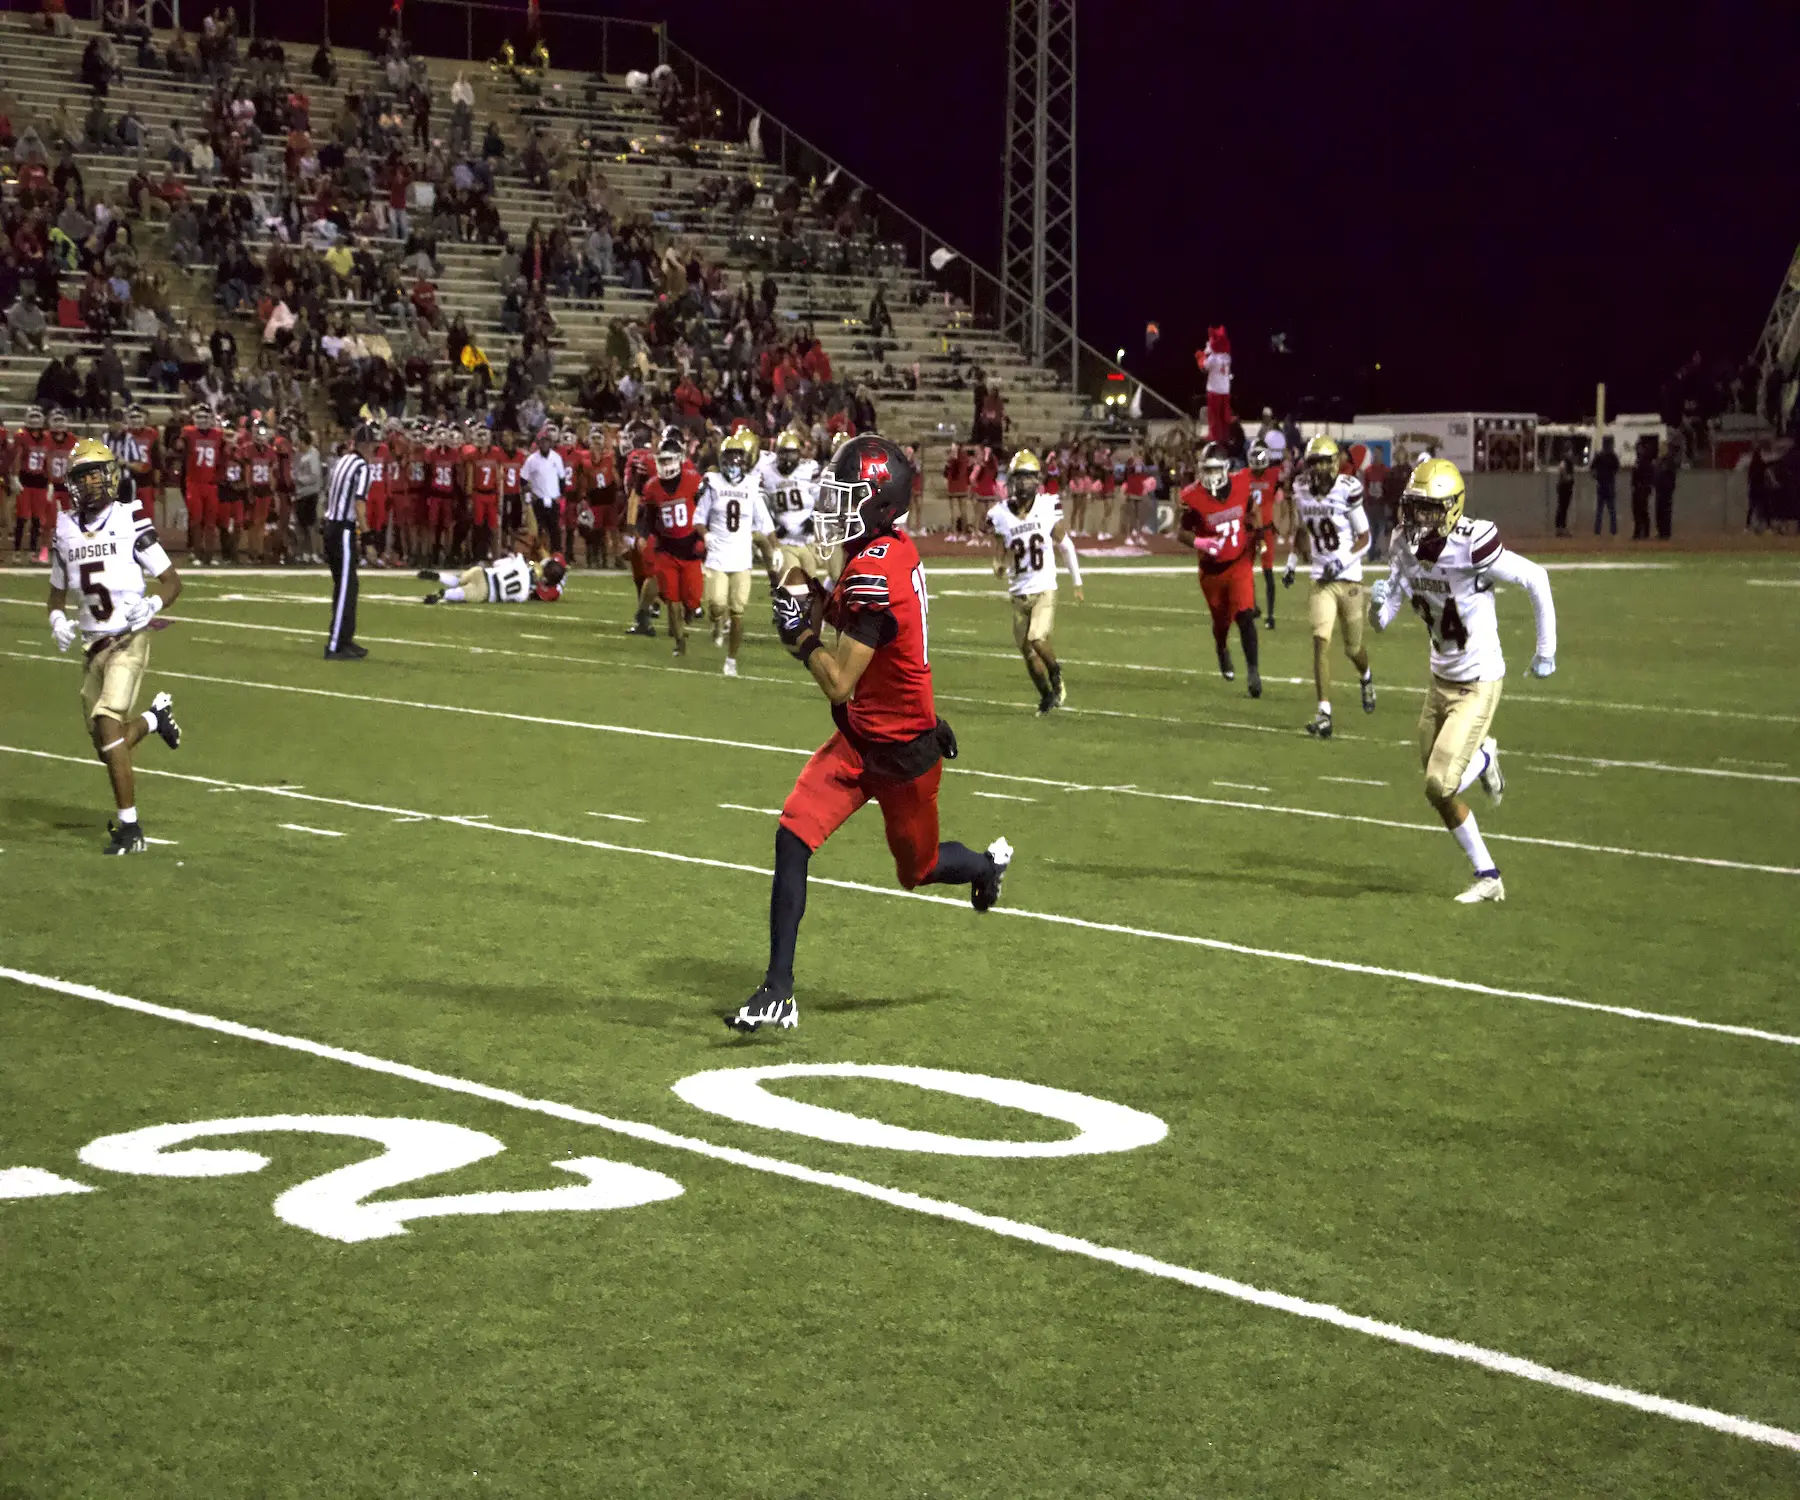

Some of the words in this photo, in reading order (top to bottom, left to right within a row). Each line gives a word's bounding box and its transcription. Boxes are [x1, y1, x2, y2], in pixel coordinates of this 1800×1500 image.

[195, 446, 215, 467] 79
[482, 466, 492, 486] 7
[776, 488, 804, 512] 99
[726, 499, 740, 532] 8
[1215, 519, 1241, 550] 71
[1307, 518, 1340, 555] 18
[68, 542, 117, 562] GADSDEN
[1010, 532, 1045, 575] 26
[79, 560, 115, 623] 5
[503, 569, 521, 596] 10
